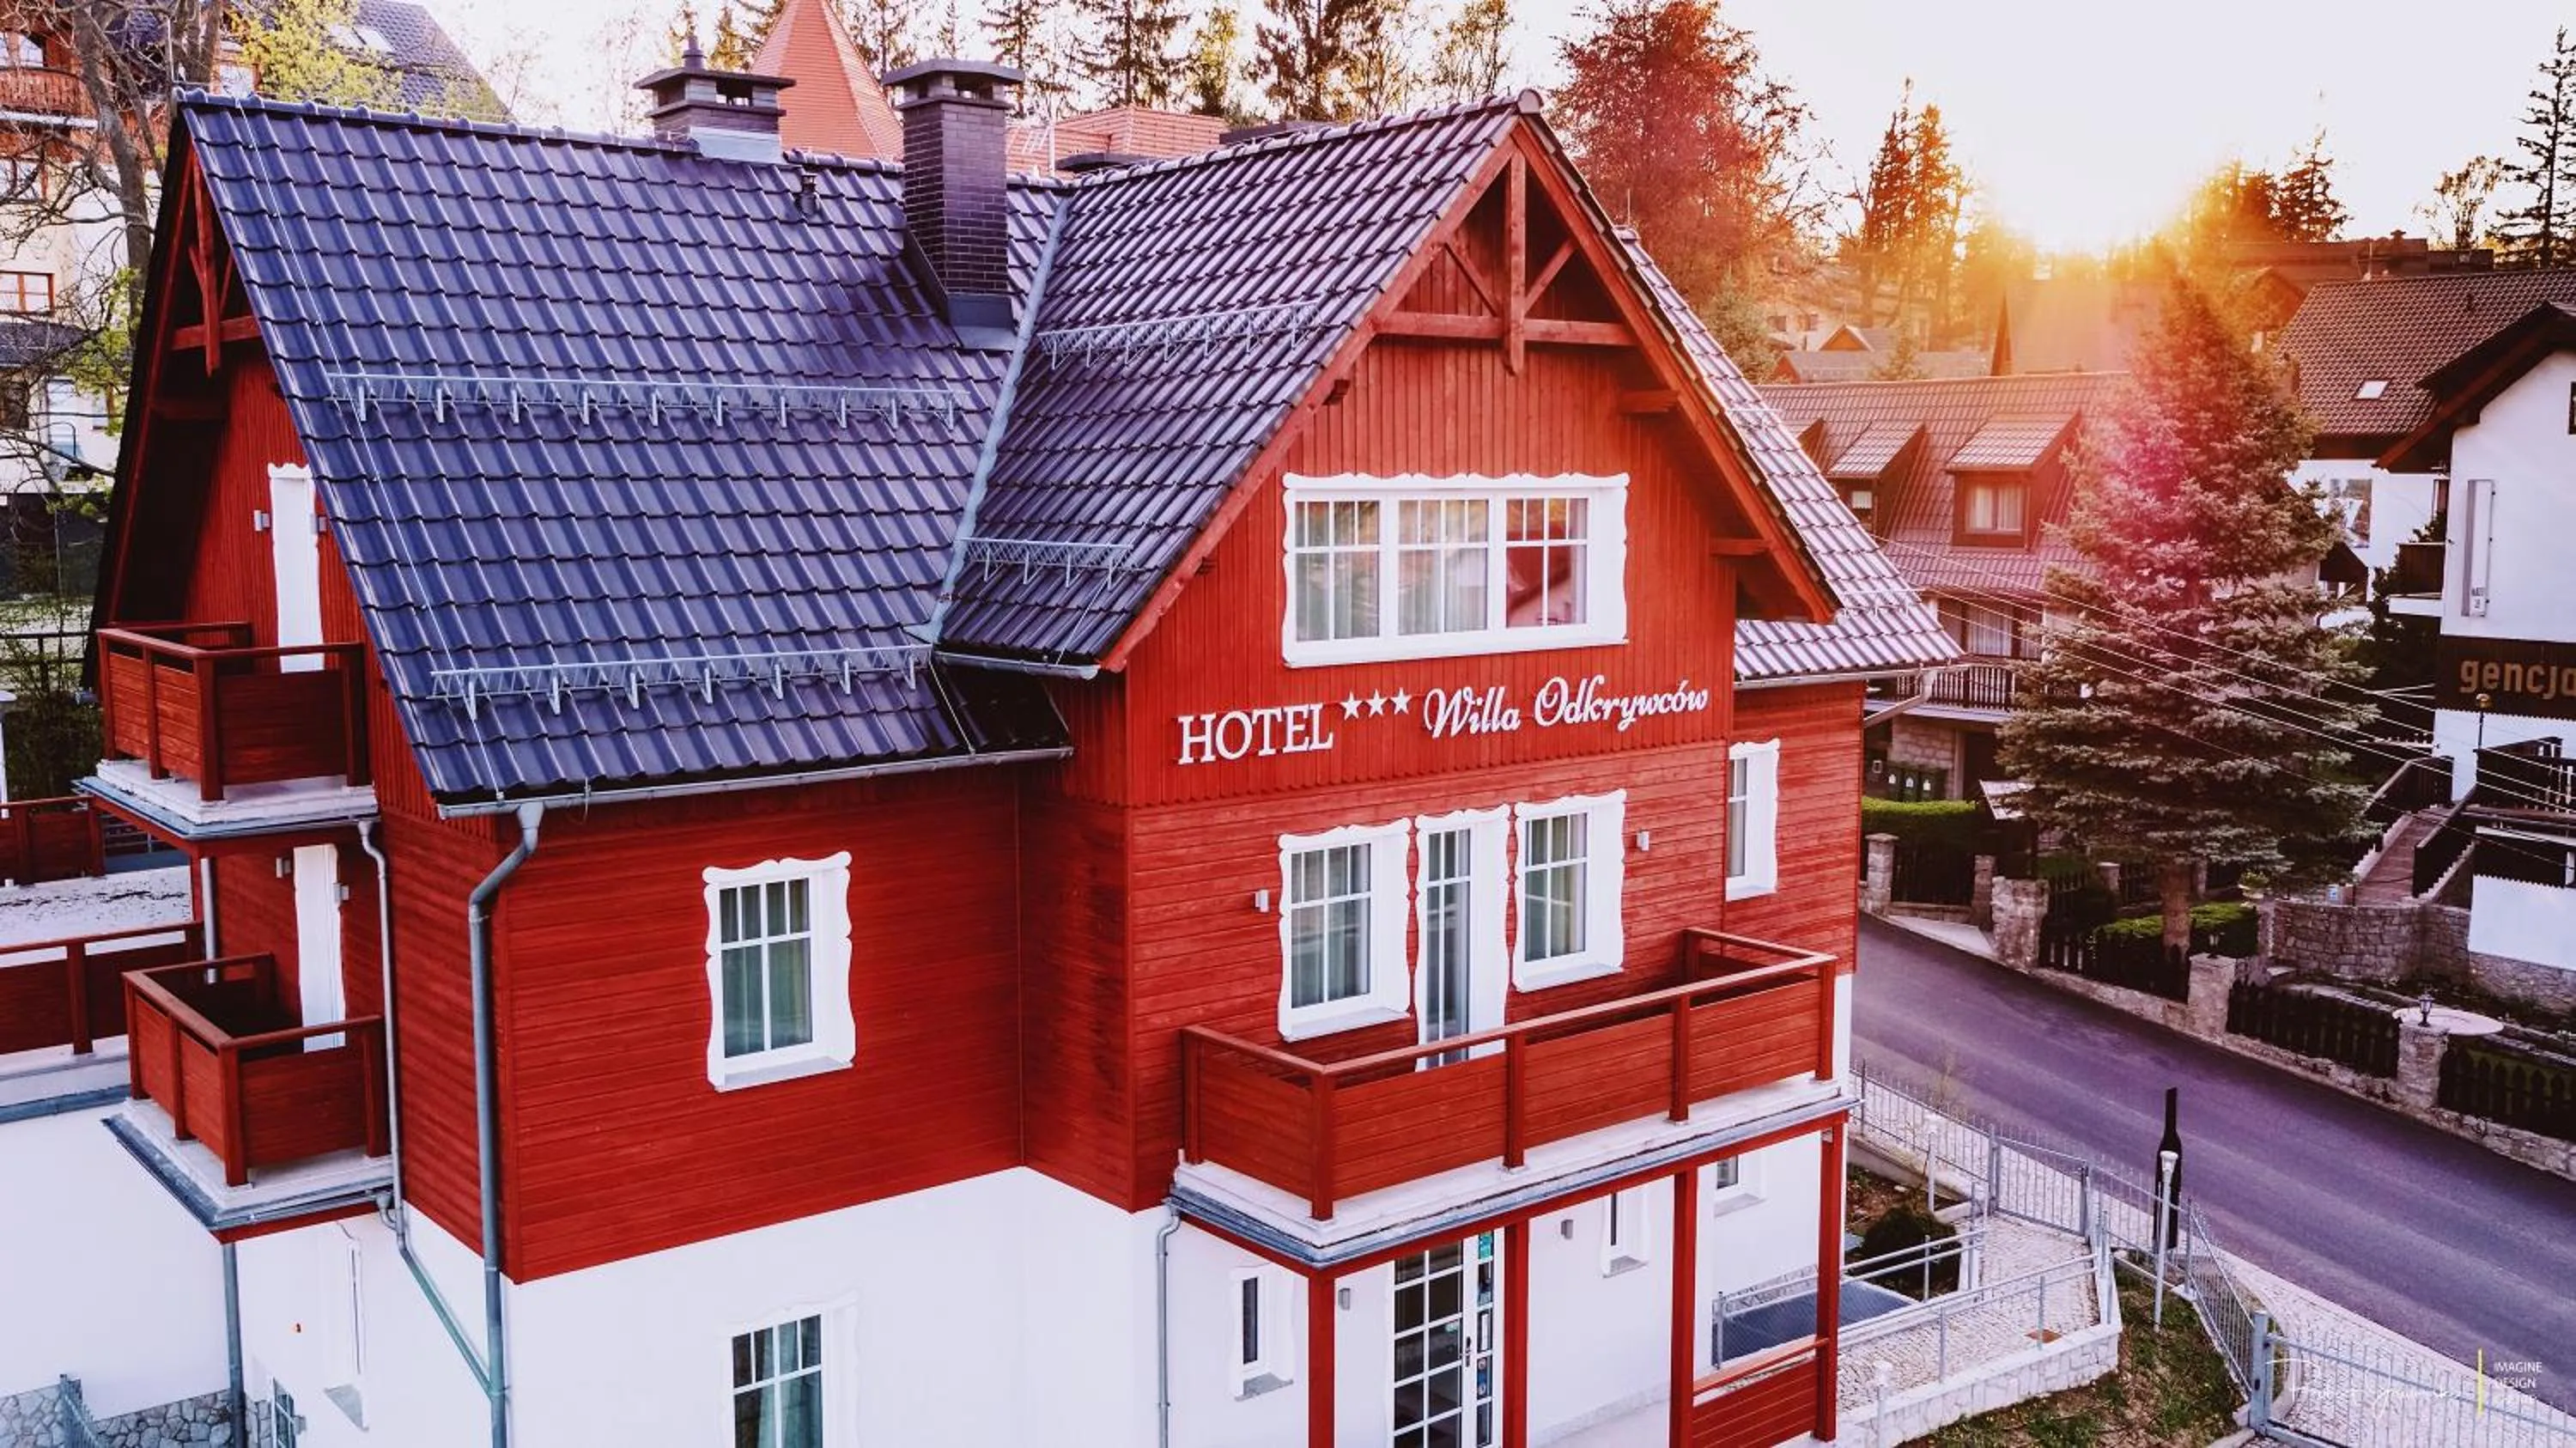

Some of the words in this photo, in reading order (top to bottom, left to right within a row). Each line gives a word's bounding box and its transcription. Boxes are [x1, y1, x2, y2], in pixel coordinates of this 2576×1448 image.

[1177, 702, 1334, 765] HOTEL
[1423, 686, 1521, 739] Willa
[1534, 674, 1709, 730] Odkrywców
